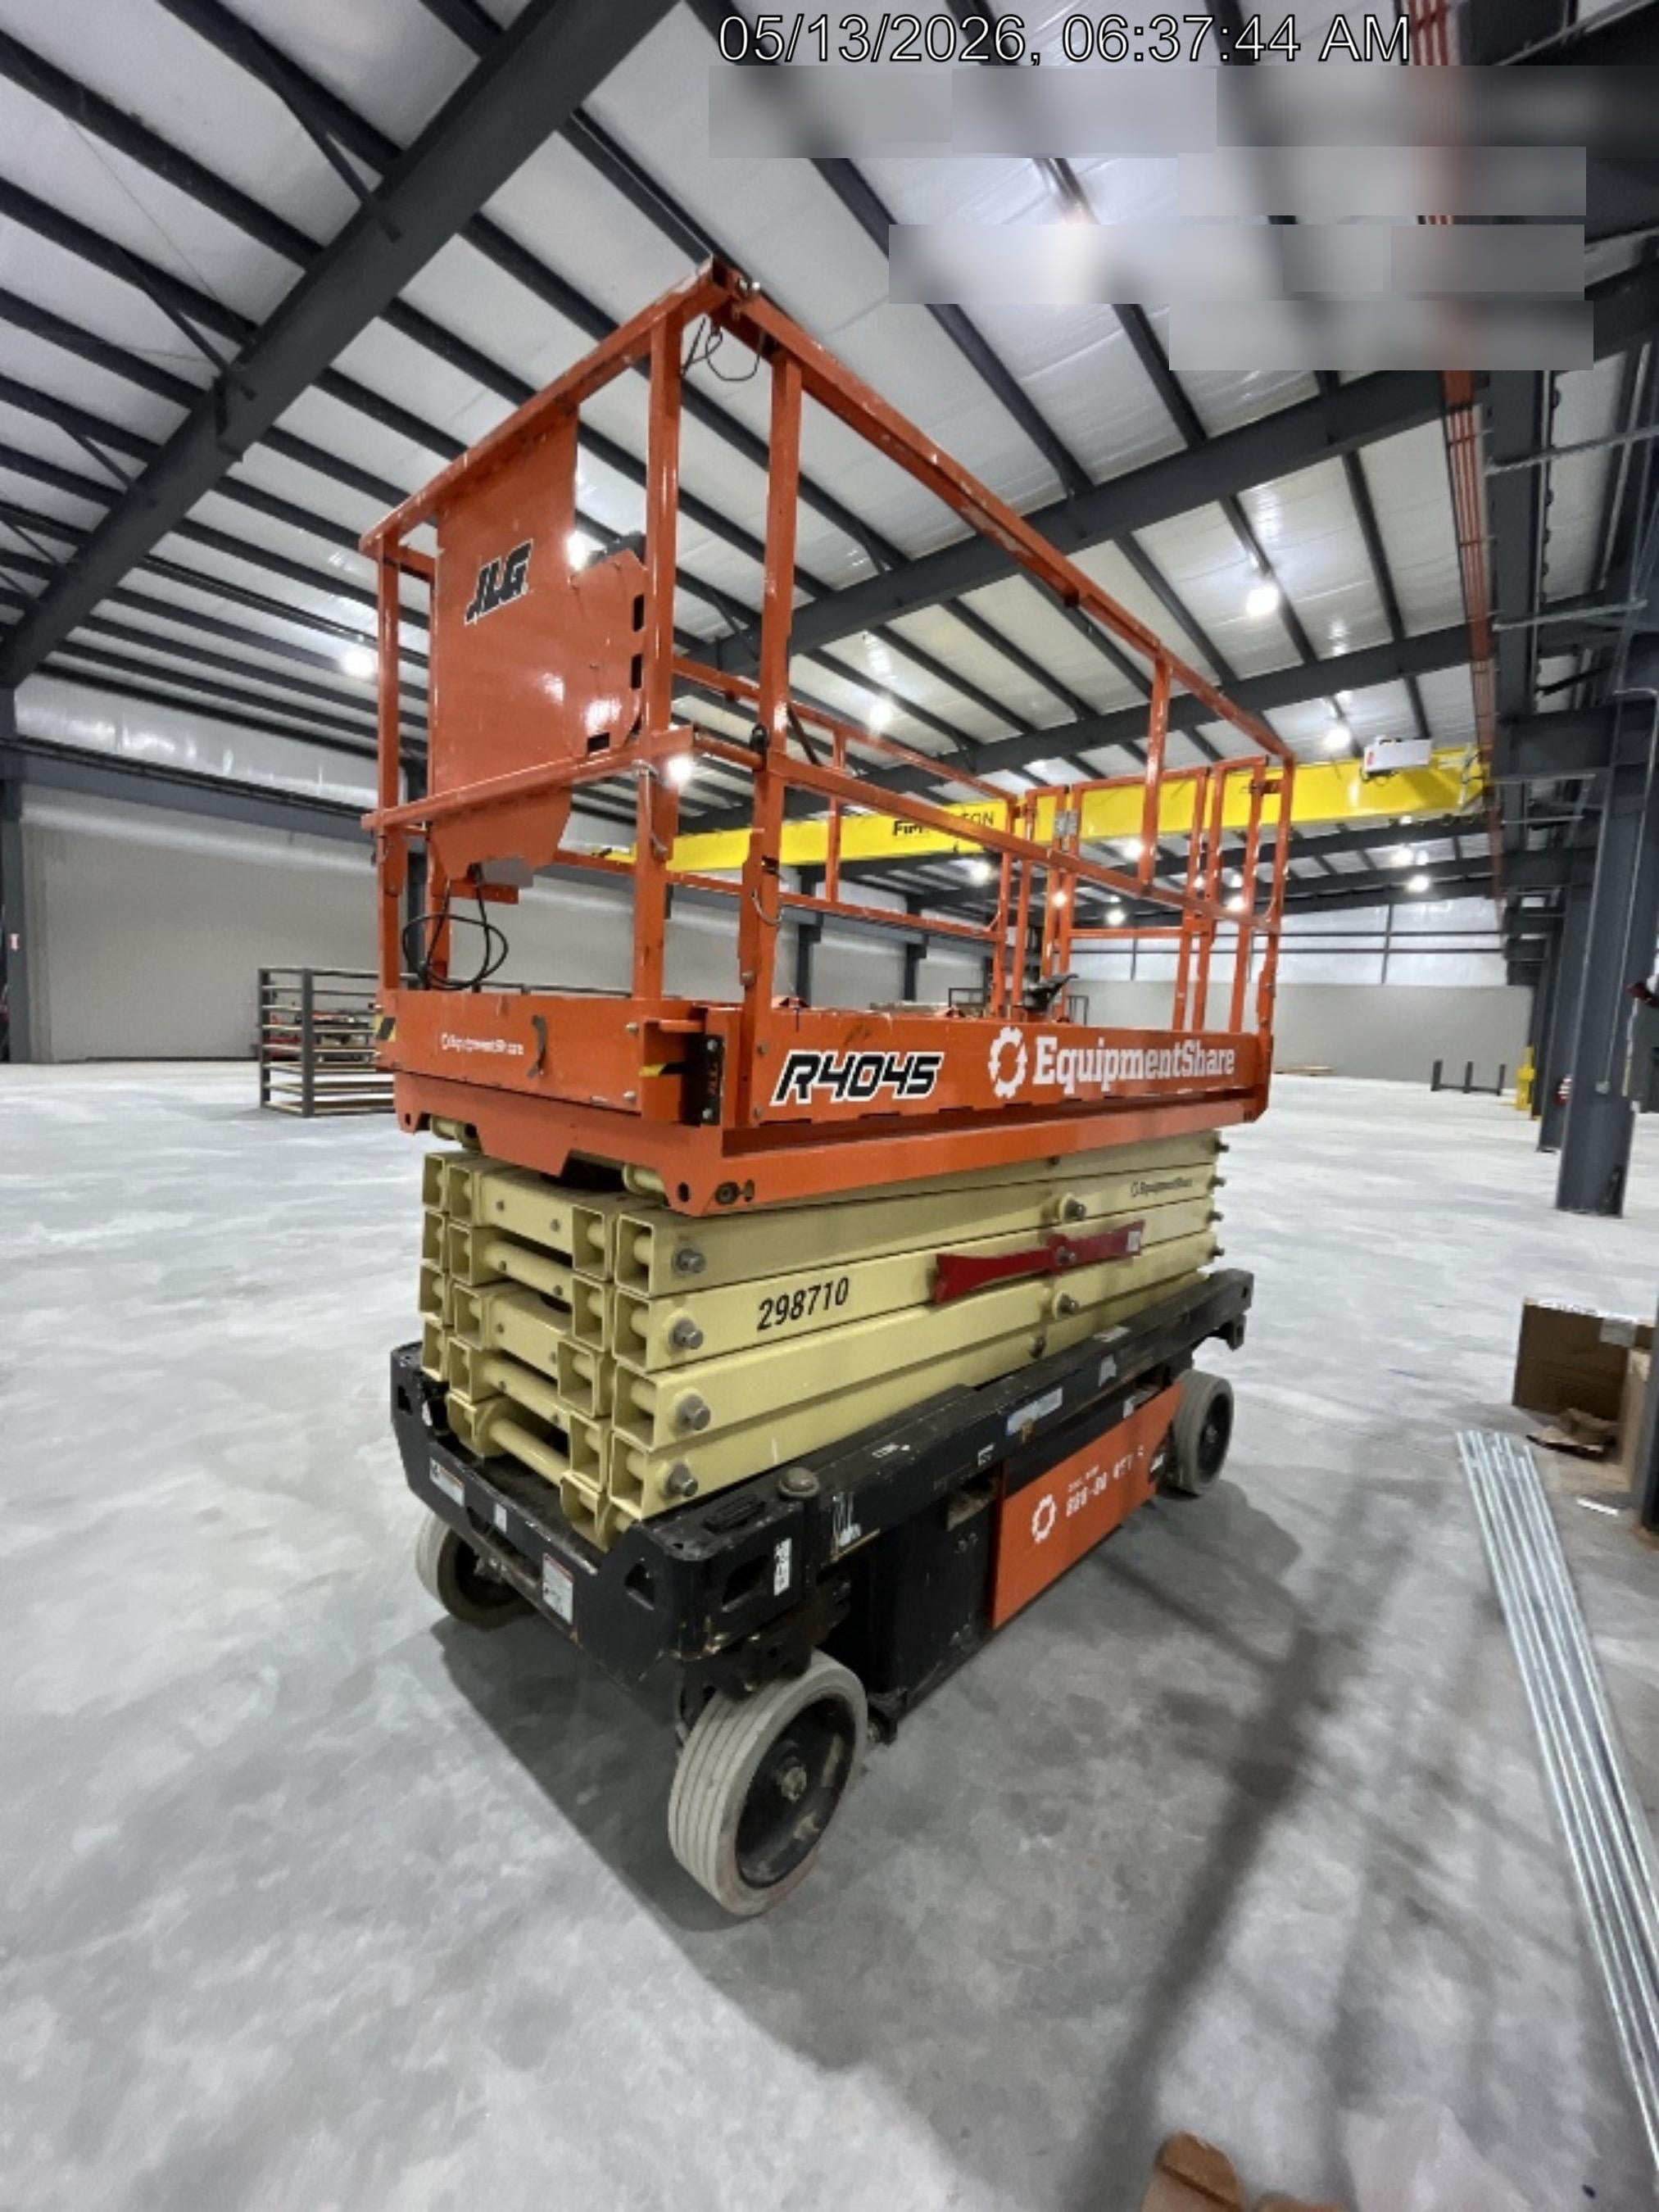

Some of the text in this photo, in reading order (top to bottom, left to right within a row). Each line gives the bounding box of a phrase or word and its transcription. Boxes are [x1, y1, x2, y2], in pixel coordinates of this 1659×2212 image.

[465, 538, 533, 625] JLG
[770, 1049, 945, 1106] R4045
[1031, 1035, 1236, 1095] EquipmentShare
[757, 1276, 850, 1332] 298710
